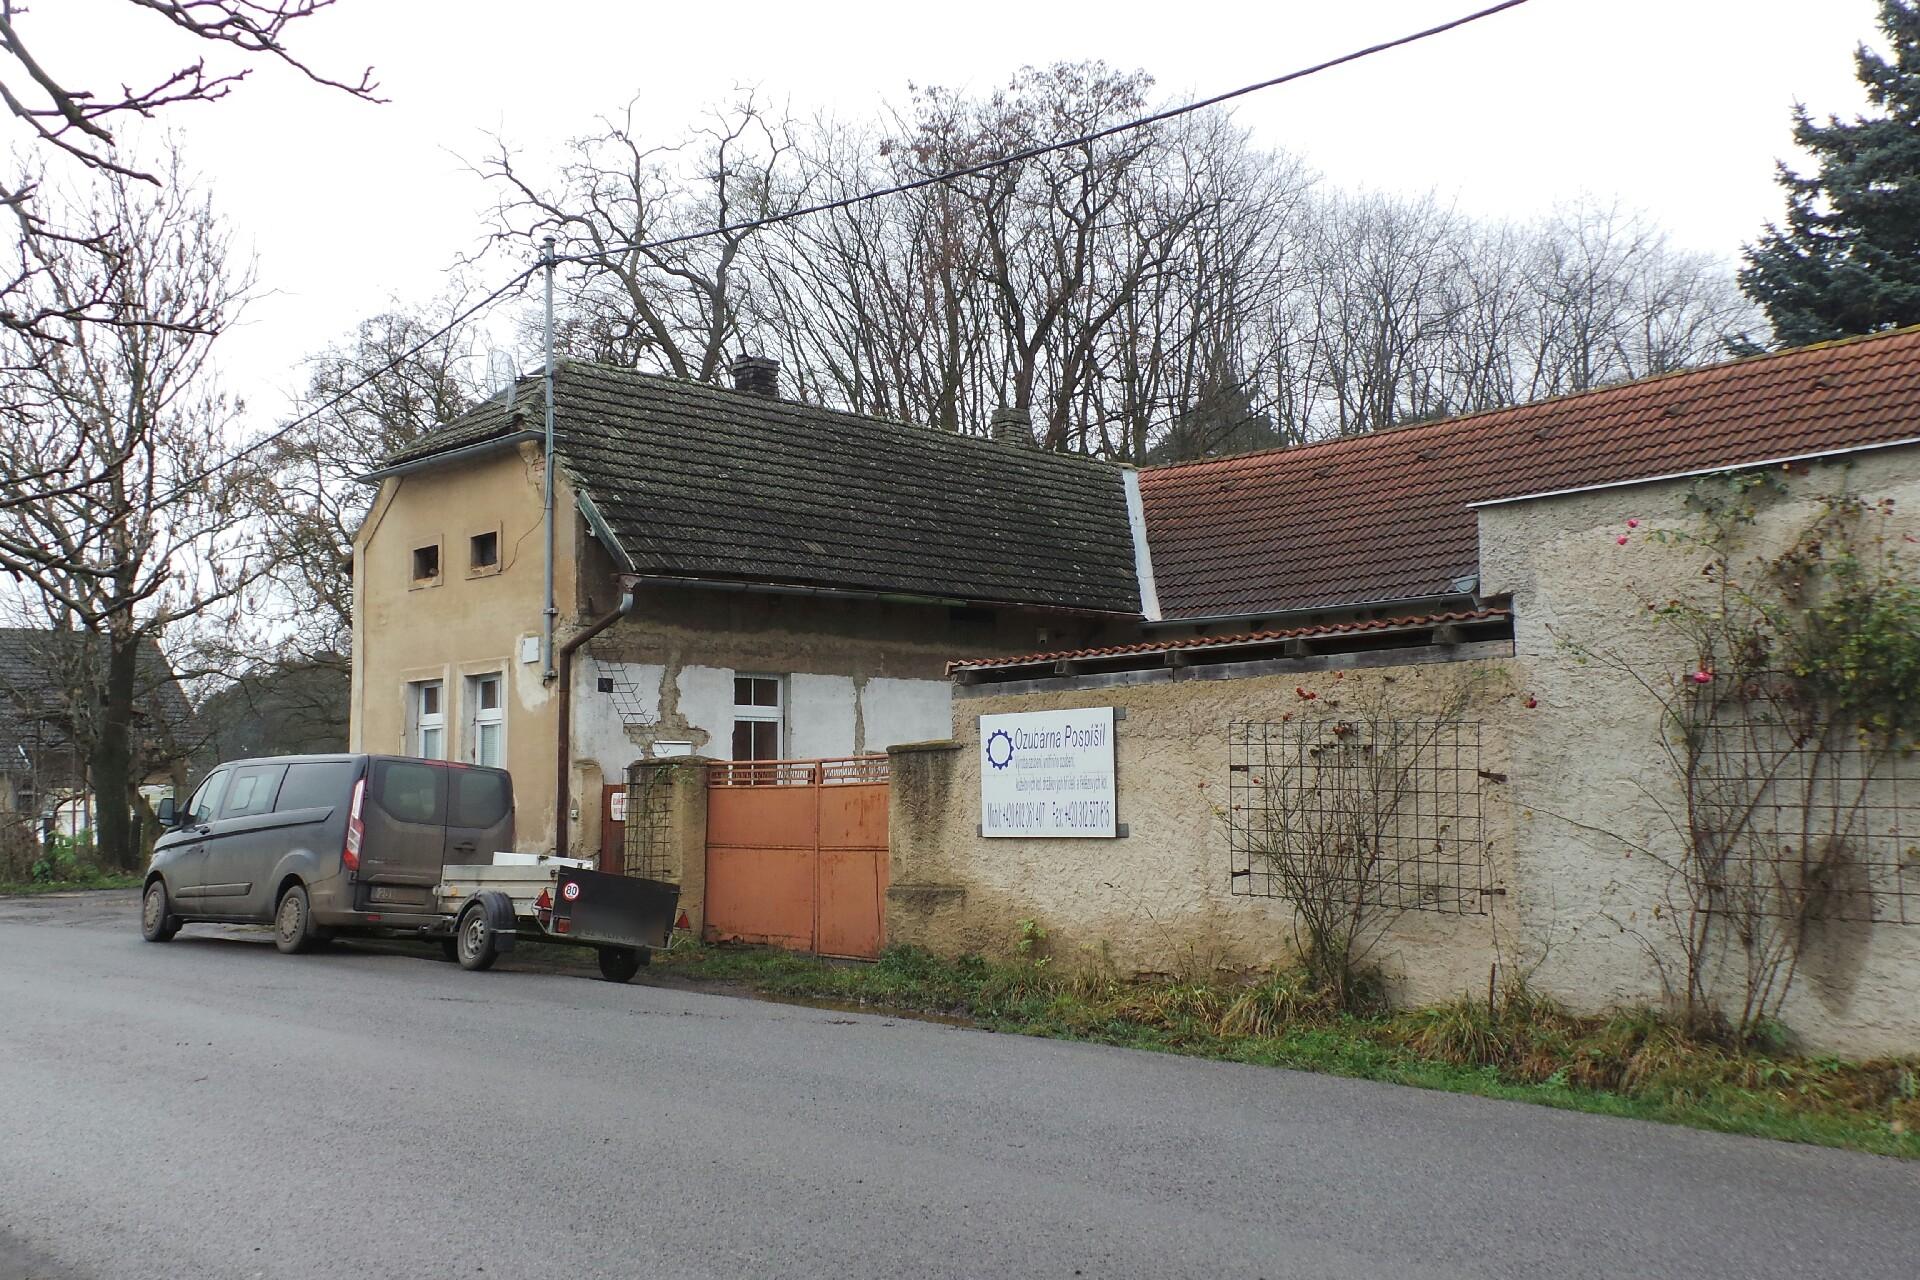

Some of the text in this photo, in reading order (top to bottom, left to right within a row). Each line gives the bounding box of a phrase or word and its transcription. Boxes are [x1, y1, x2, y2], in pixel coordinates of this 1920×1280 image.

[1064, 723, 1106, 752] Pospíšil
[1003, 802, 1015, 828] +420
[1065, 801, 1078, 828] +420
[1079, 801, 1088, 828] 312
[1089, 801, 1099, 828] 527
[566, 885, 578, 895] 80
